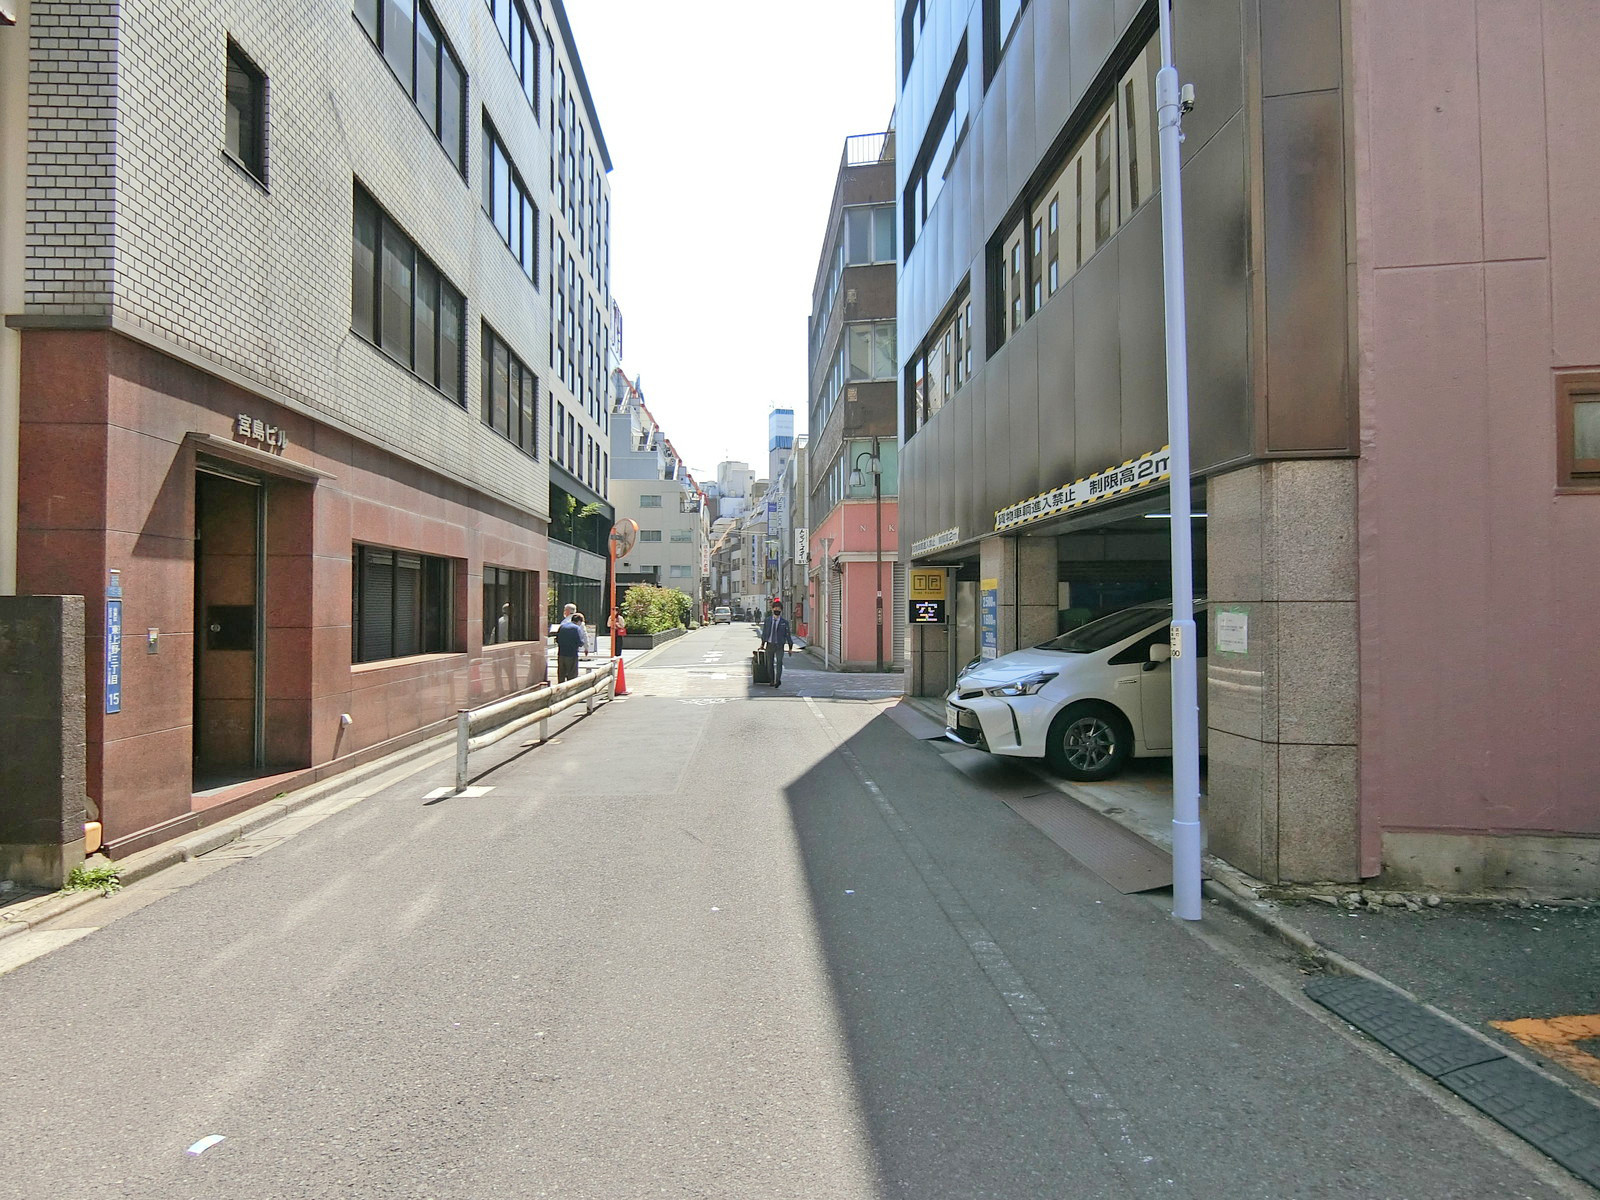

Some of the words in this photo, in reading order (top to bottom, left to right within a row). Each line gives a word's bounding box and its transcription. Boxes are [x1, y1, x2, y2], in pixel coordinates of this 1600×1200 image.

[238, 413, 288, 448] 宮島ビル
[916, 601, 938, 621] 空
[111, 625, 121, 685] 東上野三丁目
[109, 693, 120, 706] 15
